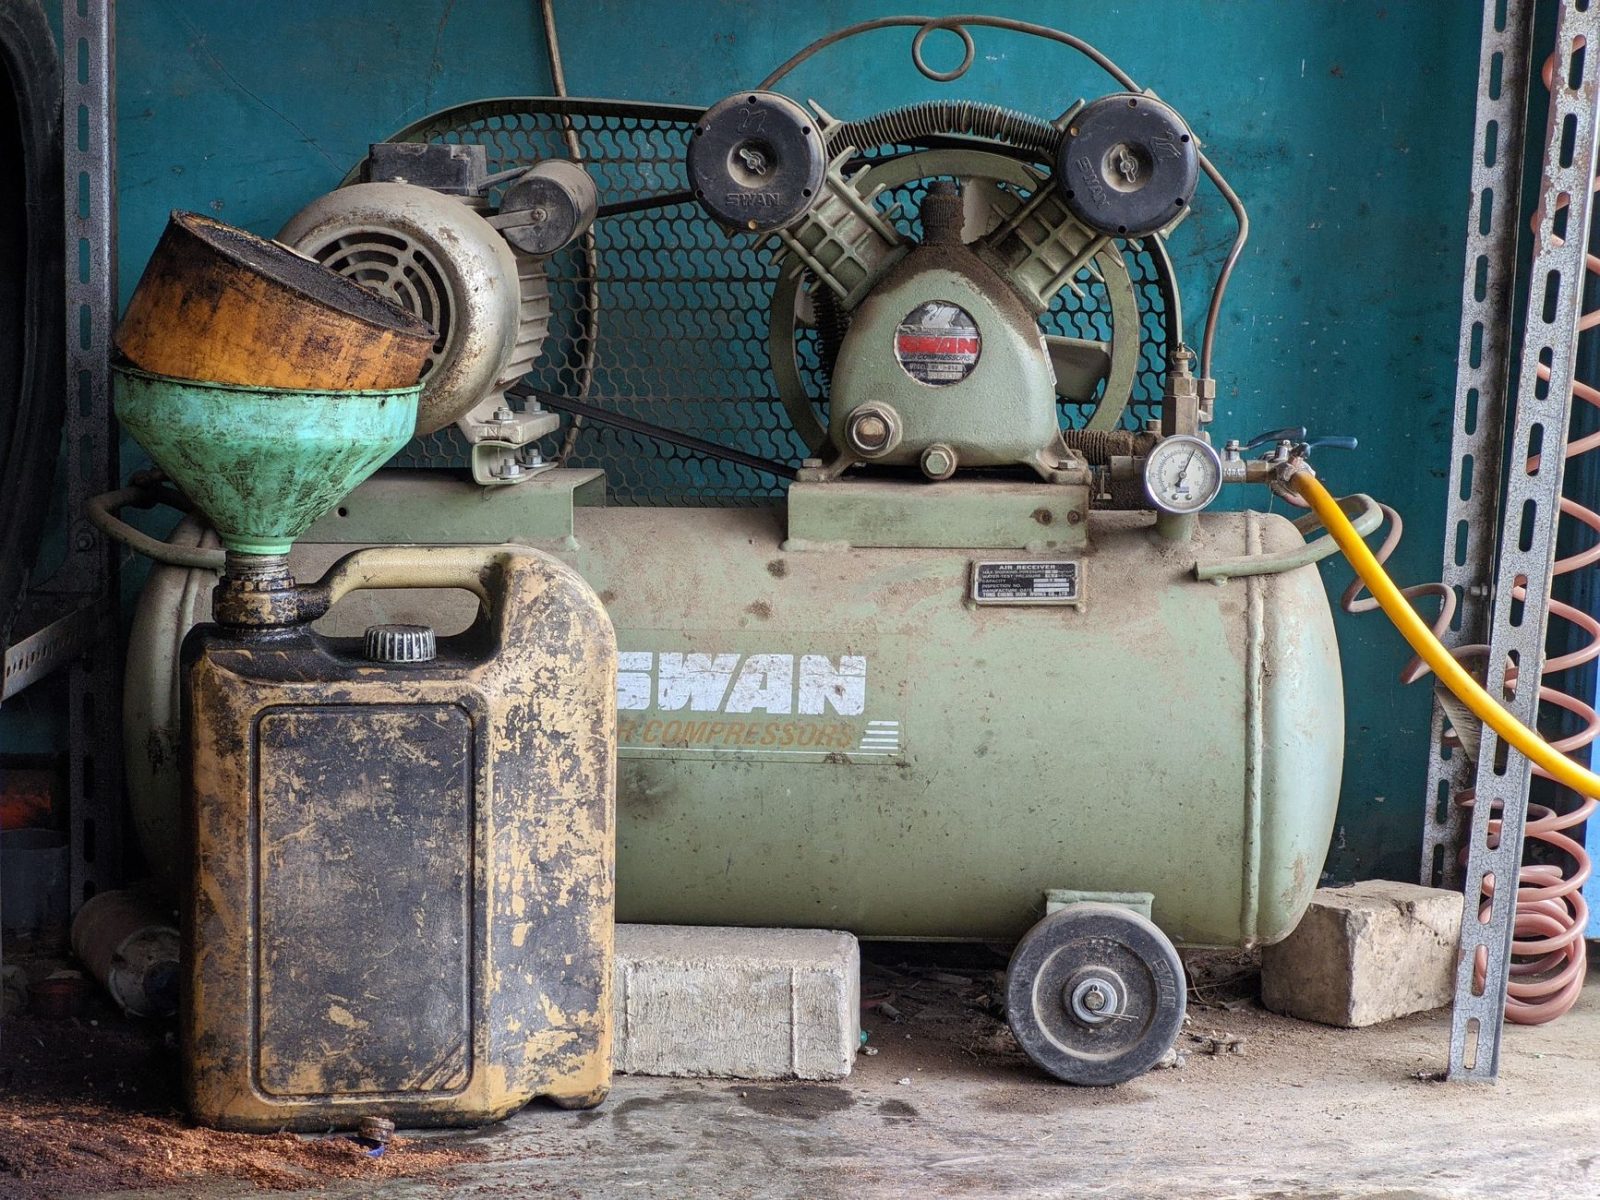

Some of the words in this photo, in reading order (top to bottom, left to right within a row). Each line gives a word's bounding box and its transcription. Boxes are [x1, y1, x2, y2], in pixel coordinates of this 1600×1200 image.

[726, 192, 780, 207] SWAN
[899, 336, 977, 354] SWAN
[917, 353, 972, 362] COMPRESSORS
[617, 651, 867, 716] SWAN
[642, 719, 853, 748] COMPRESSORS
